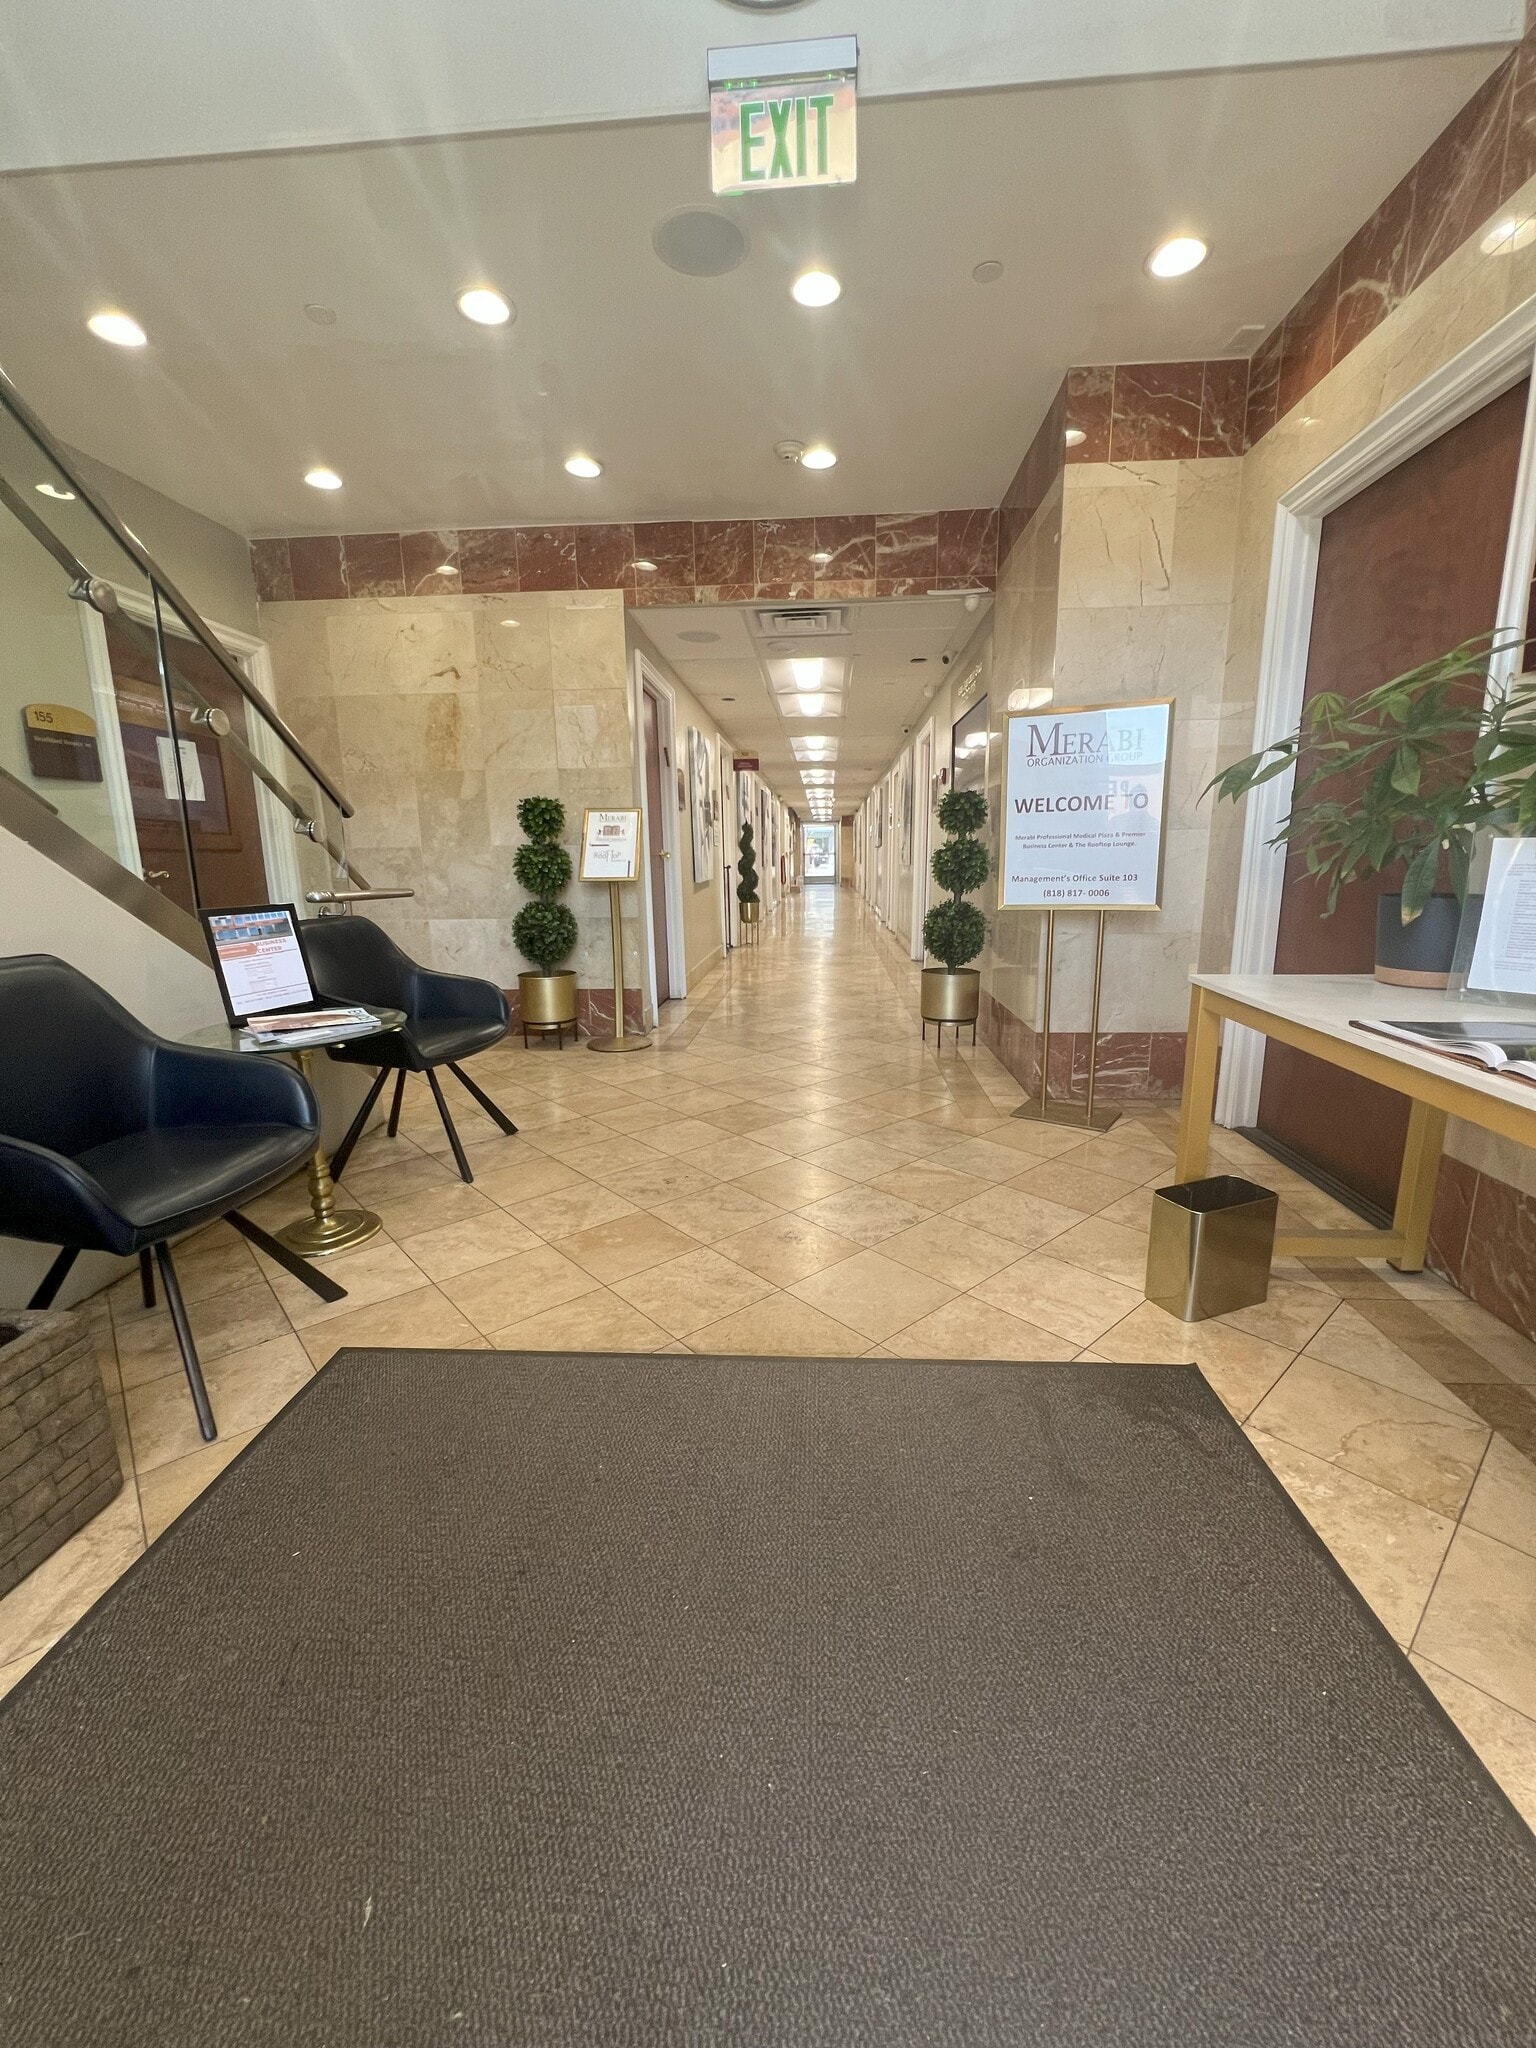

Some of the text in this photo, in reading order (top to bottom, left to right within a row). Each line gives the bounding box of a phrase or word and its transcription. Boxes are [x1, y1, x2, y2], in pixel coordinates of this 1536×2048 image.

[739, 95, 834, 182] EXIT
[34, 711, 54, 723] 155
[1026, 723, 1144, 757] MERABI
[1026, 751, 1143, 767] ORGANIZATION GROUP
[1014, 793, 1149, 814] WELCOME TO
[1087, 841, 1111, 849] Rooftop
[1012, 873, 1138, 884] Management's Office Suite 103
[1043, 888, 1110, 899] (818) 817- 0006
[257, 946, 282, 954] CENTER
